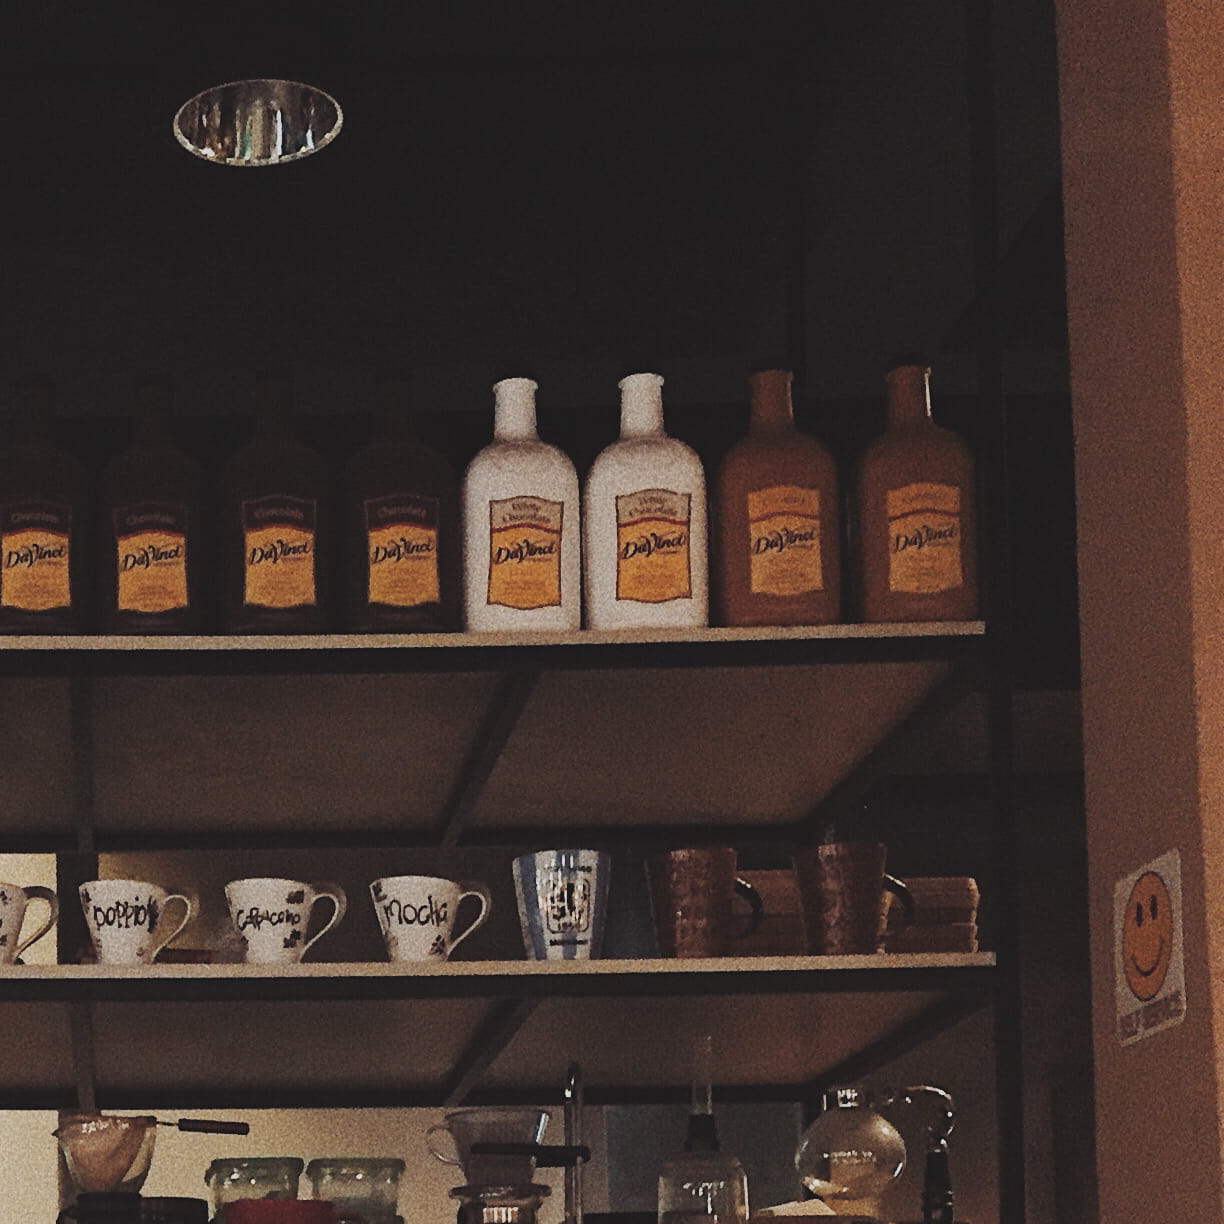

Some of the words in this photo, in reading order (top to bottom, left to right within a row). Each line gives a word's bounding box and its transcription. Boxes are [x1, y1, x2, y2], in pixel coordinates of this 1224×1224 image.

[372, 537, 433, 564] DaVinci
[620, 533, 684, 559] DaVinci
[754, 527, 816, 554] DaVinci
[894, 525, 957, 552] DaVinci
[6, 544, 65, 568] DaVinci
[122, 546, 181, 571] DaVinci
[249, 540, 309, 564] DaVinci
[495, 540, 554, 564] DaVinci
